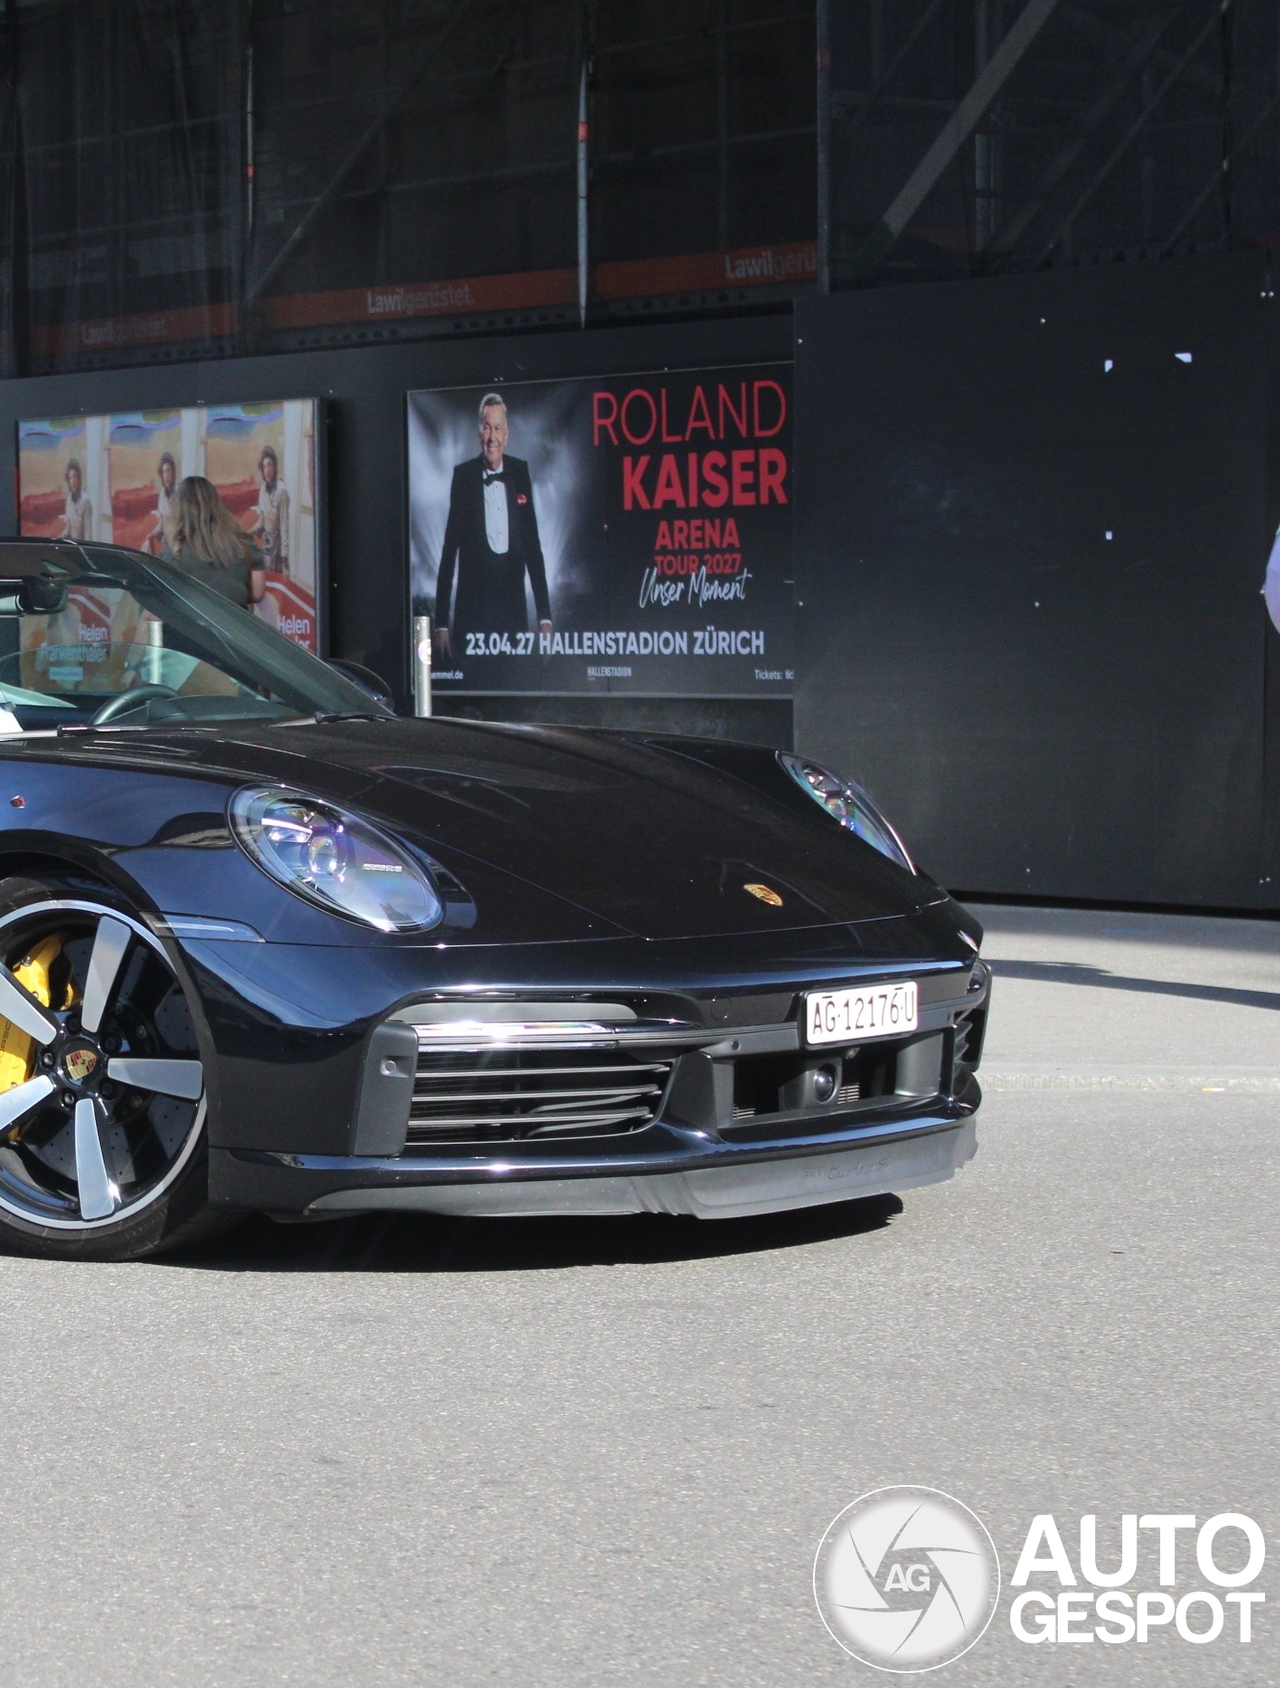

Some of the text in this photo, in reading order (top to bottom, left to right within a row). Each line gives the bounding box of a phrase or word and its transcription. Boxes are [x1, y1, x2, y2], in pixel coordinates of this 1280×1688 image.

[593, 380, 786, 446] ROLAND
[623, 448, 788, 510] KAISER
[655, 518, 740, 550] ARENA
[654, 553, 742, 575] TOUR 2027
[639, 565, 752, 608] Unser Moment
[80, 624, 107, 641] Helen
[278, 615, 310, 634] Helen
[466, 625, 765, 655] 23.04.27 HALLENSTADION ZÜRICH
[754, 669, 783, 680] Tickets:
